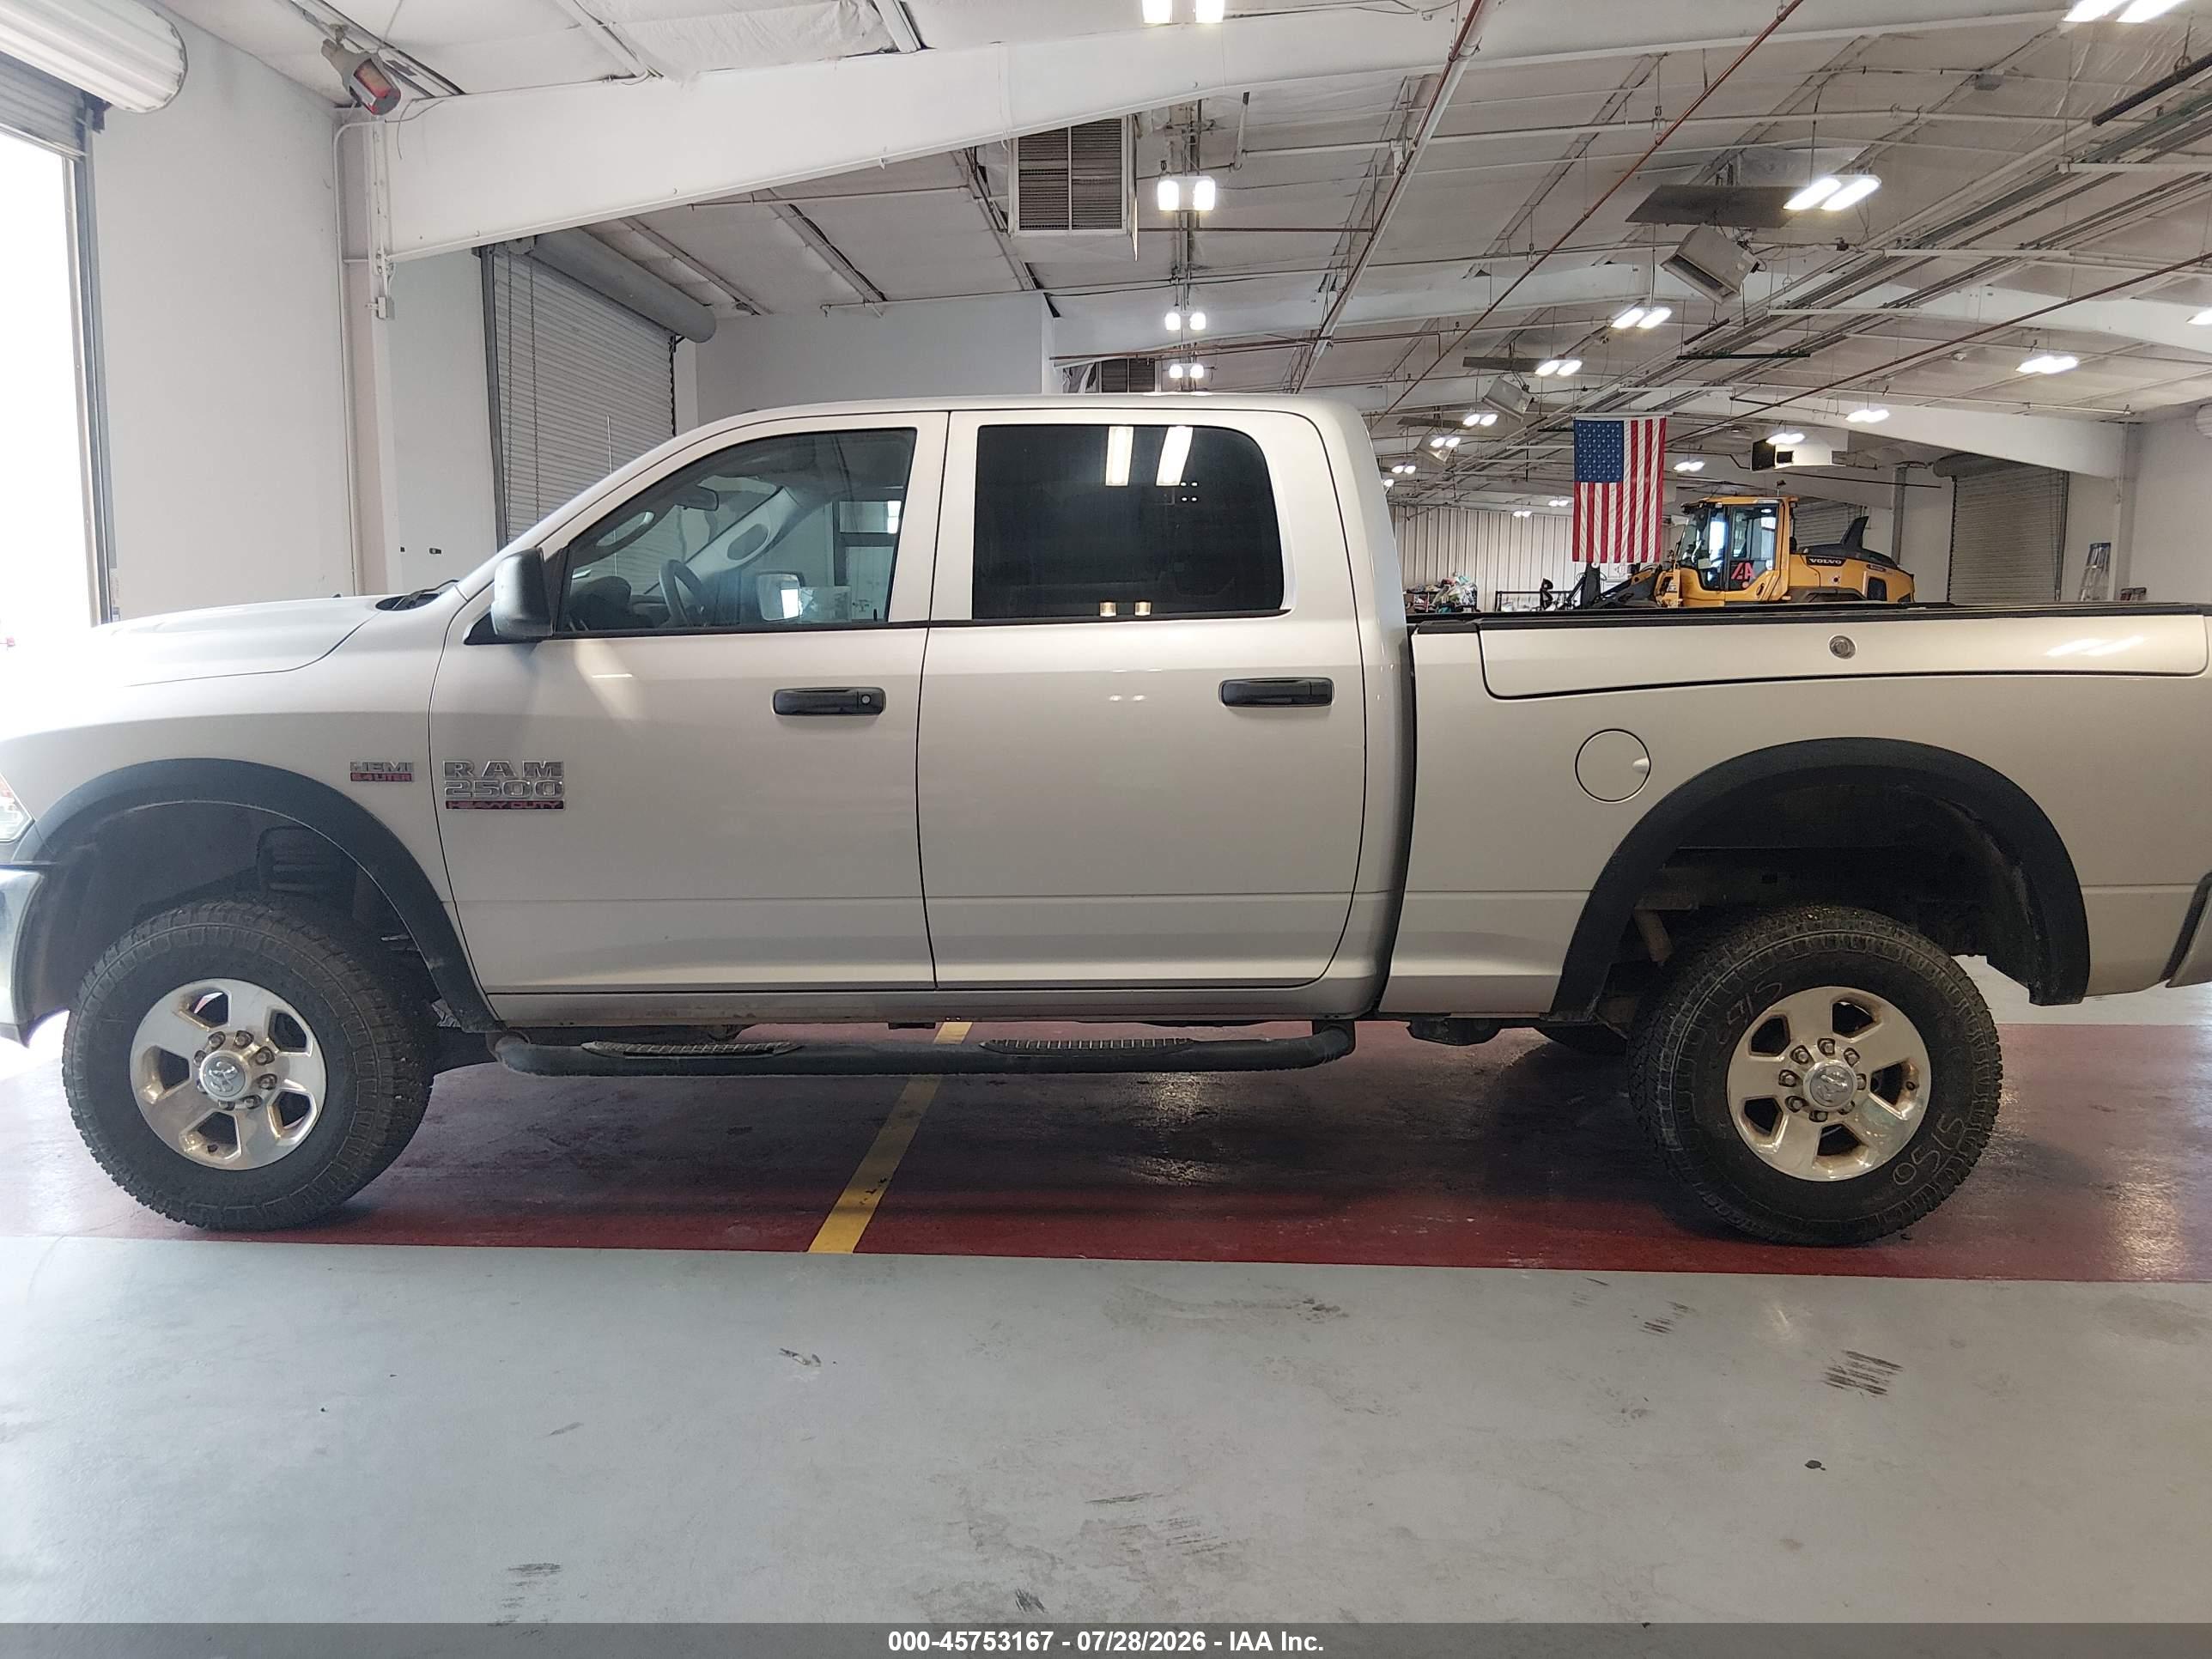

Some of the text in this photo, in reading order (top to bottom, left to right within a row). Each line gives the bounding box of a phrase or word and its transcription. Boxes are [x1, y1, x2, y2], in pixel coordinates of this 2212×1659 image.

[350, 761, 413, 772] HEMI
[443, 760, 563, 778] RAM
[444, 780, 563, 799] 2500
